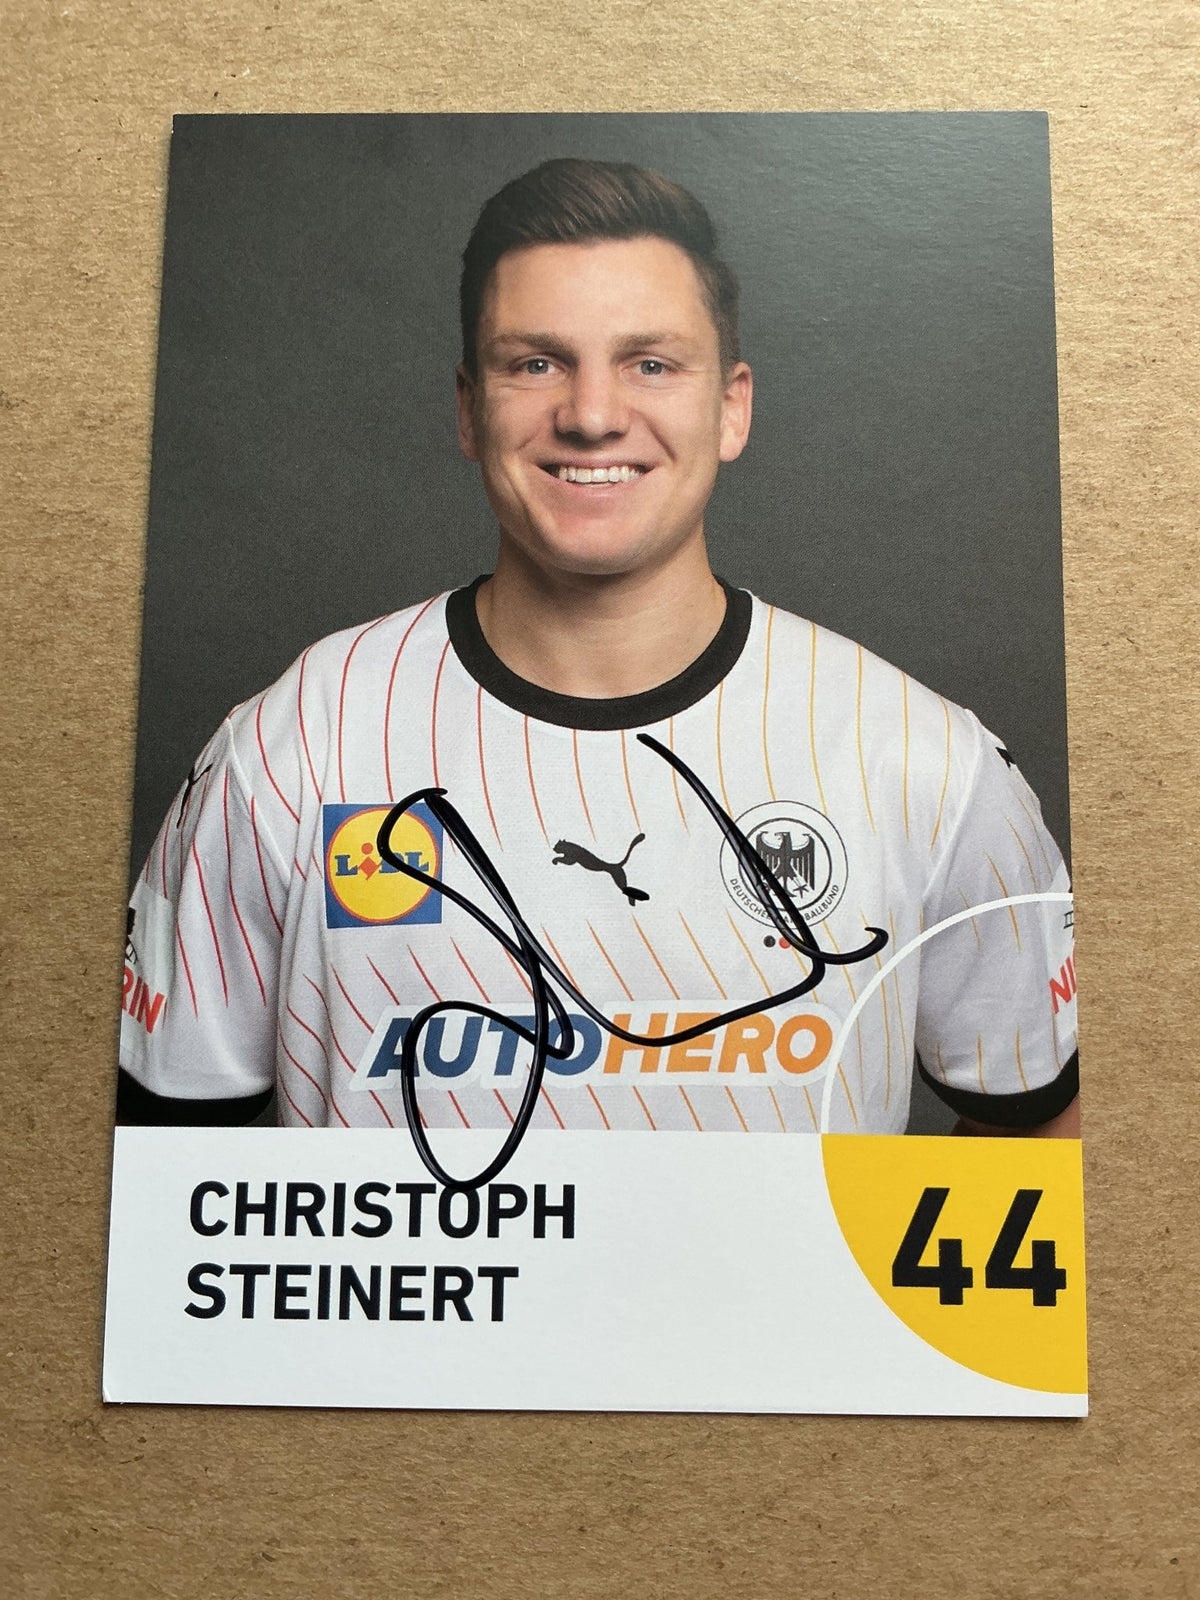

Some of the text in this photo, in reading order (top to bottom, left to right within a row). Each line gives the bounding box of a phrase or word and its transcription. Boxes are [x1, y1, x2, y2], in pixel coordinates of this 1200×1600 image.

[367, 1011, 833, 1078] AUTOHERO
[189, 1180, 576, 1239] CHRISTOPH
[892, 1187, 1067, 1306] 44
[184, 1262, 519, 1321] STEINERT
